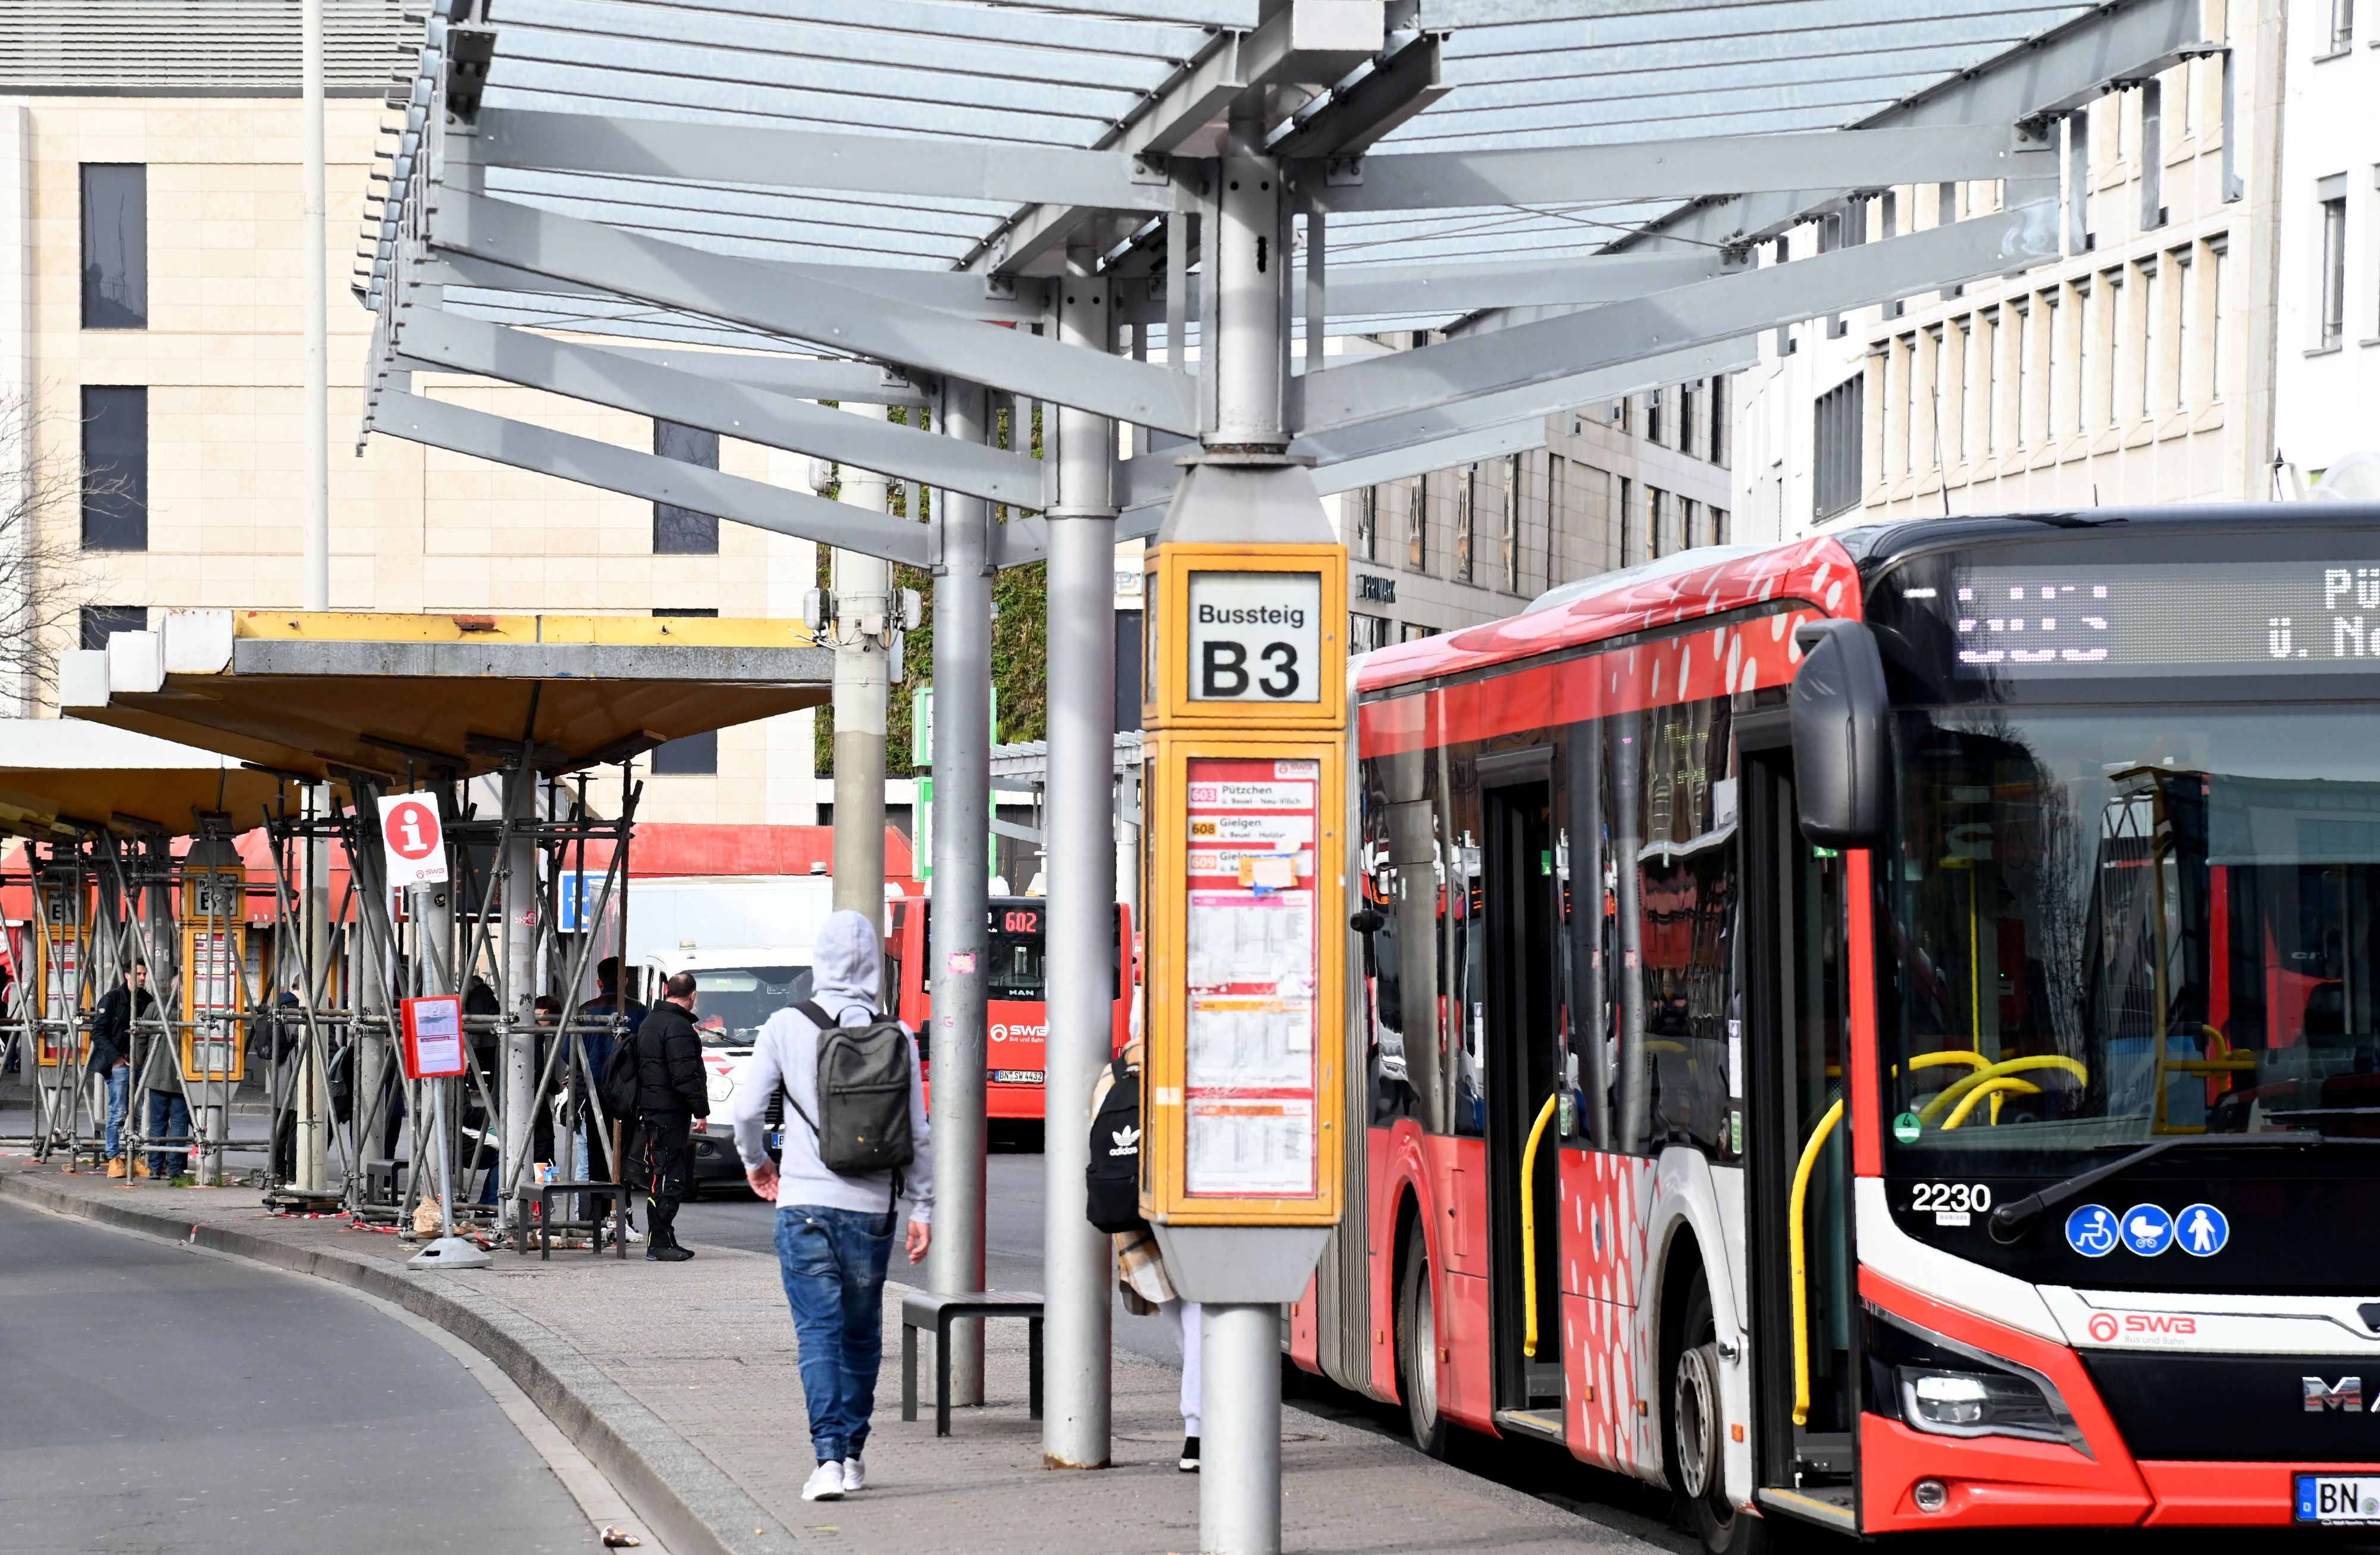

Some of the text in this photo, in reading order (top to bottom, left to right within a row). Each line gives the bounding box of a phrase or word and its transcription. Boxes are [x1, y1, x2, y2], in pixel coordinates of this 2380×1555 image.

[1364, 575, 1395, 603] PRIMARK
[1198, 604, 1304, 628] Bussteig
[2269, 617, 2307, 658] ü.
[1202, 641, 1299, 698] B3
[1191, 789, 1216, 801] 603
[1222, 785, 1272, 794] Pützchen
[1191, 824, 1216, 835] 608
[1220, 818, 1261, 829] Gielgen
[1191, 856, 1216, 868] 609
[1006, 912, 1037, 932] 602
[1010, 1025, 1048, 1036] SWB
[1903, 1113, 1911, 1128] 4
[1109, 1146, 1138, 1156] adidas
[1912, 1183, 1991, 1212] 2230
[2126, 1315, 2196, 1334] SWB
[2125, 1335, 2185, 1346] Bus und Bahn
[2302, 1376, 2380, 1412] M
[2320, 1483, 2357, 1513] BN
